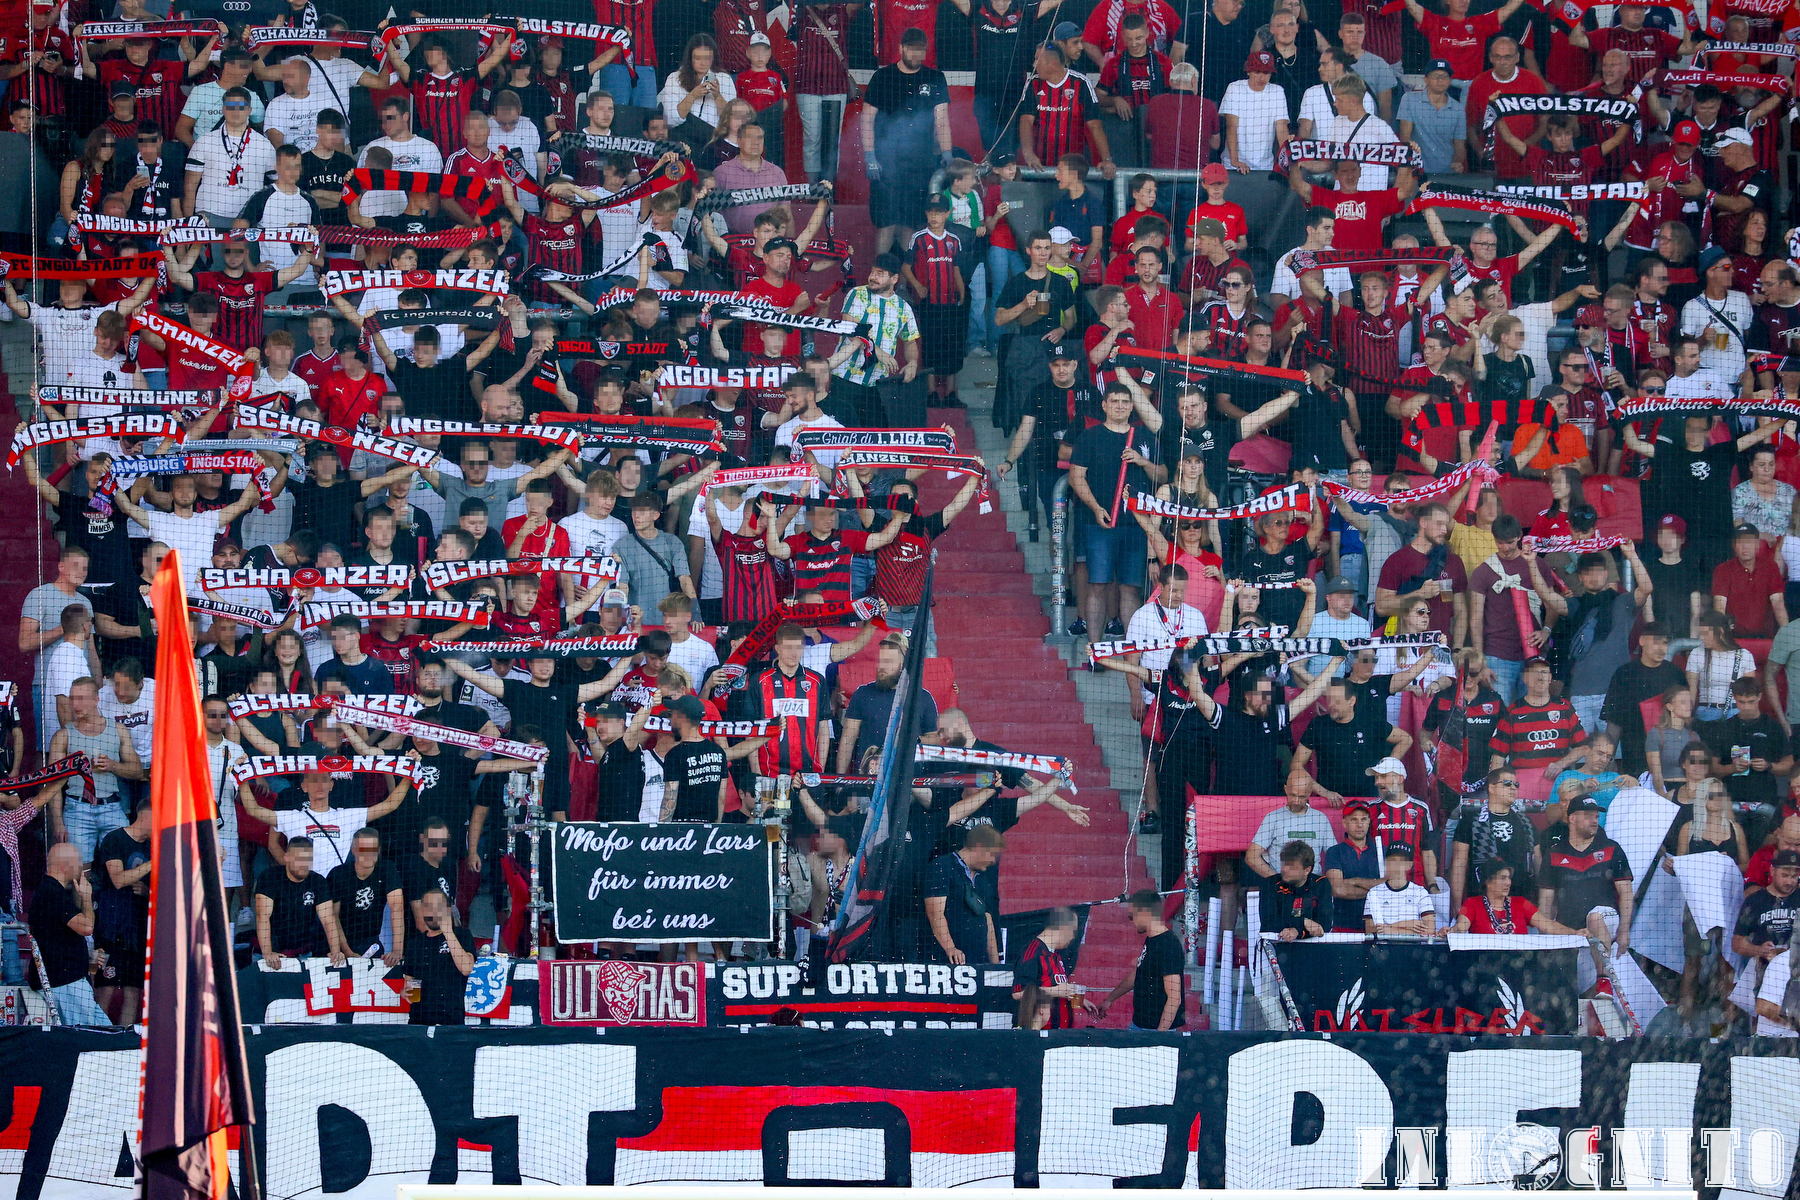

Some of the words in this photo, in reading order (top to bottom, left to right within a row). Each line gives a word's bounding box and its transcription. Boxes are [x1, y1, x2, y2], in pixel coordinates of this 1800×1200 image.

[253, 27, 328, 43] SCHANZER
[1664, 72, 1702, 83] Audi
[1495, 96, 1638, 120] INGOLSTADT
[585, 135, 656, 156] SCHANZER
[1289, 140, 1409, 165] SCHANZER
[731, 183, 812, 203] SCHANZER
[1335, 203, 1366, 219] EVERLAST
[12, 259, 32, 272] FC
[37, 258, 135, 272] INGOLSTADT
[138, 256, 159, 271] 04
[1318, 248, 1447, 264] INGOLSTADT
[382, 312, 400, 322] FC
[475, 309, 495, 320] 04
[135, 311, 248, 373] SCHANZER
[389, 415, 579, 448] INGOLSTADT
[890, 432, 926, 445] LIGA
[637, 436, 711, 455] Company
[728, 469, 791, 482] INGOLSTADT
[794, 467, 808, 478] 04
[1136, 484, 1300, 520] INGOLSTADT
[198, 599, 211, 609] FC
[303, 600, 486, 625] INGOLSTADT
[828, 602, 846, 614] 04
[430, 640, 532, 654] Südtribüne
[543, 632, 639, 658] Ingolstadt
[1533, 741, 1556, 751] Audi
[686, 756, 700, 768] 15
[699, 751, 723, 766] JAHRE
[561, 825, 633, 861] Mofo
[640, 828, 697, 851] und
[703, 826, 761, 855] Lars
[588, 867, 637, 901] für
[643, 870, 734, 890] immer
[612, 907, 656, 930] bei
[662, 911, 716, 929] uns
[722, 963, 978, 999] SUPORTERS
